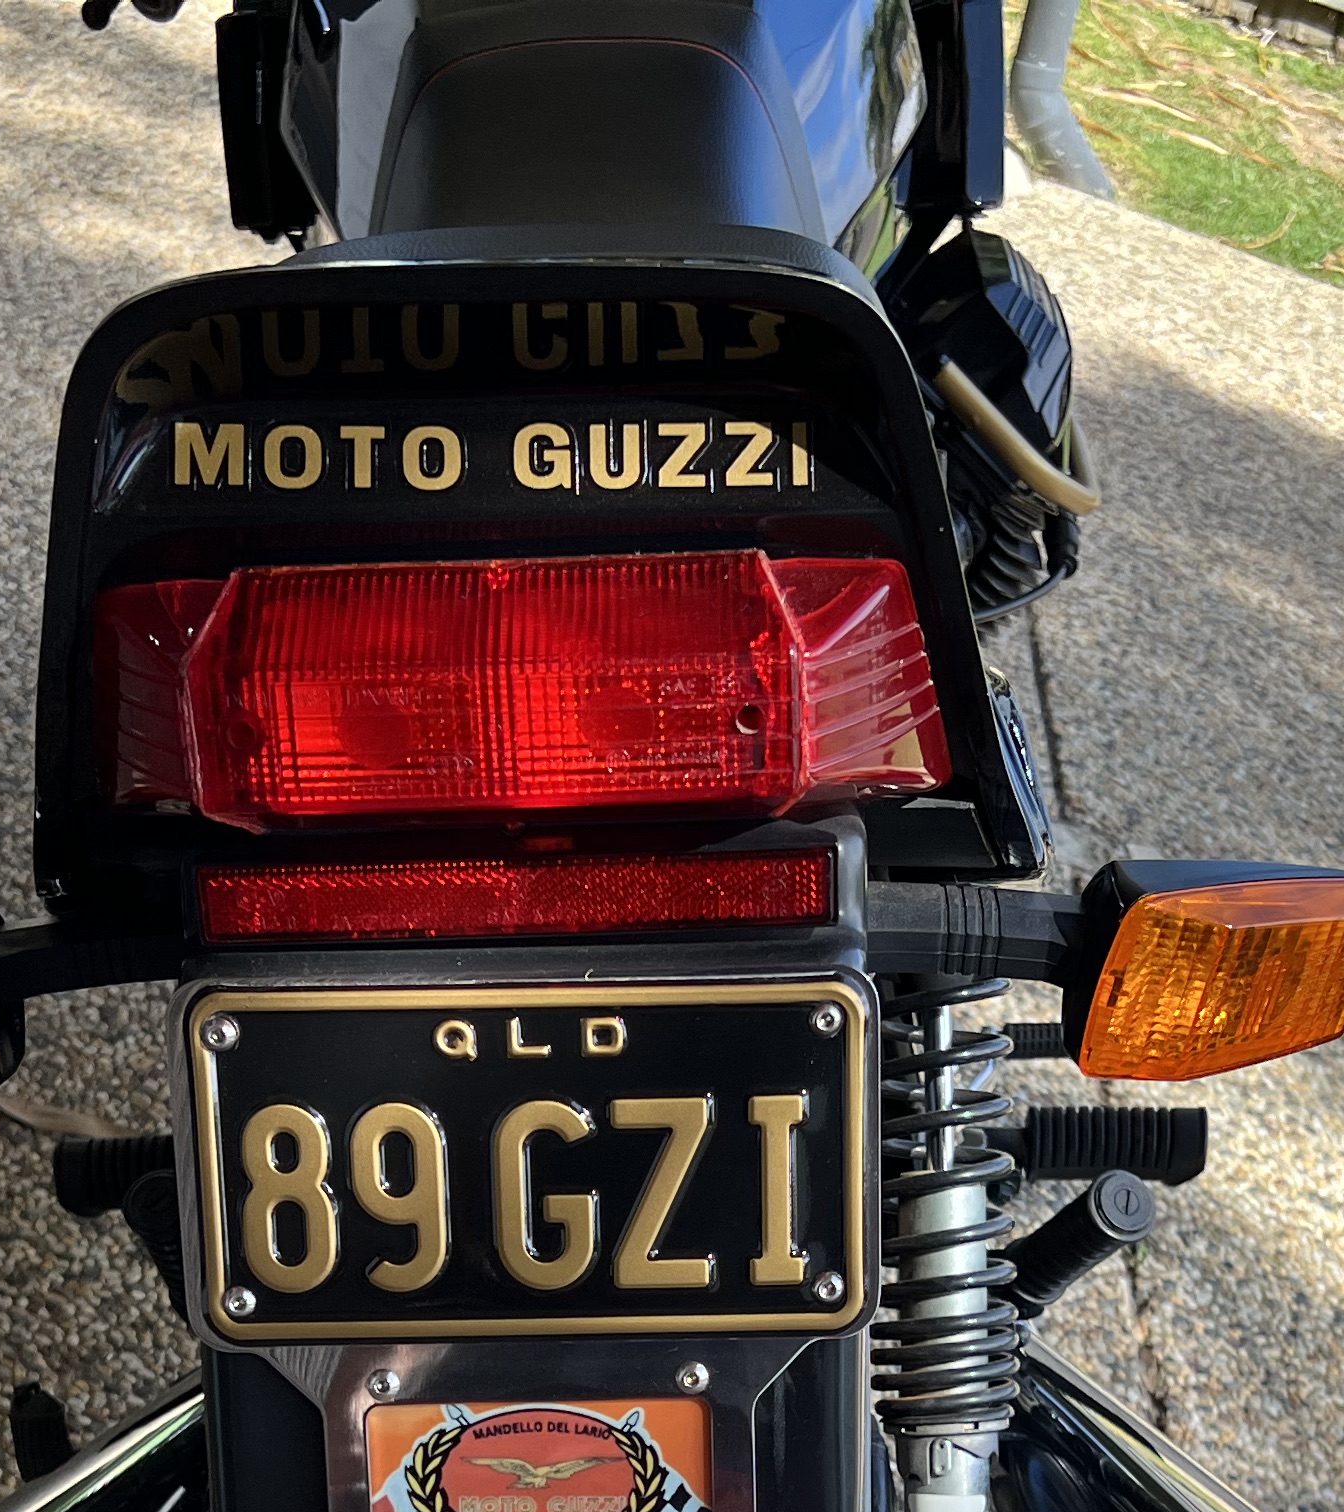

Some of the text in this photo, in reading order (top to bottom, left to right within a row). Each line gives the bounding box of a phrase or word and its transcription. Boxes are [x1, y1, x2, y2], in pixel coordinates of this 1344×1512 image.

[173, 420, 812, 491] MOTO GUZZI
[432, 1015, 627, 1061] QLD
[240, 1093, 808, 1296] 89 GZI
[472, 1421, 612, 1441] MANDELLO DEL LARIO
